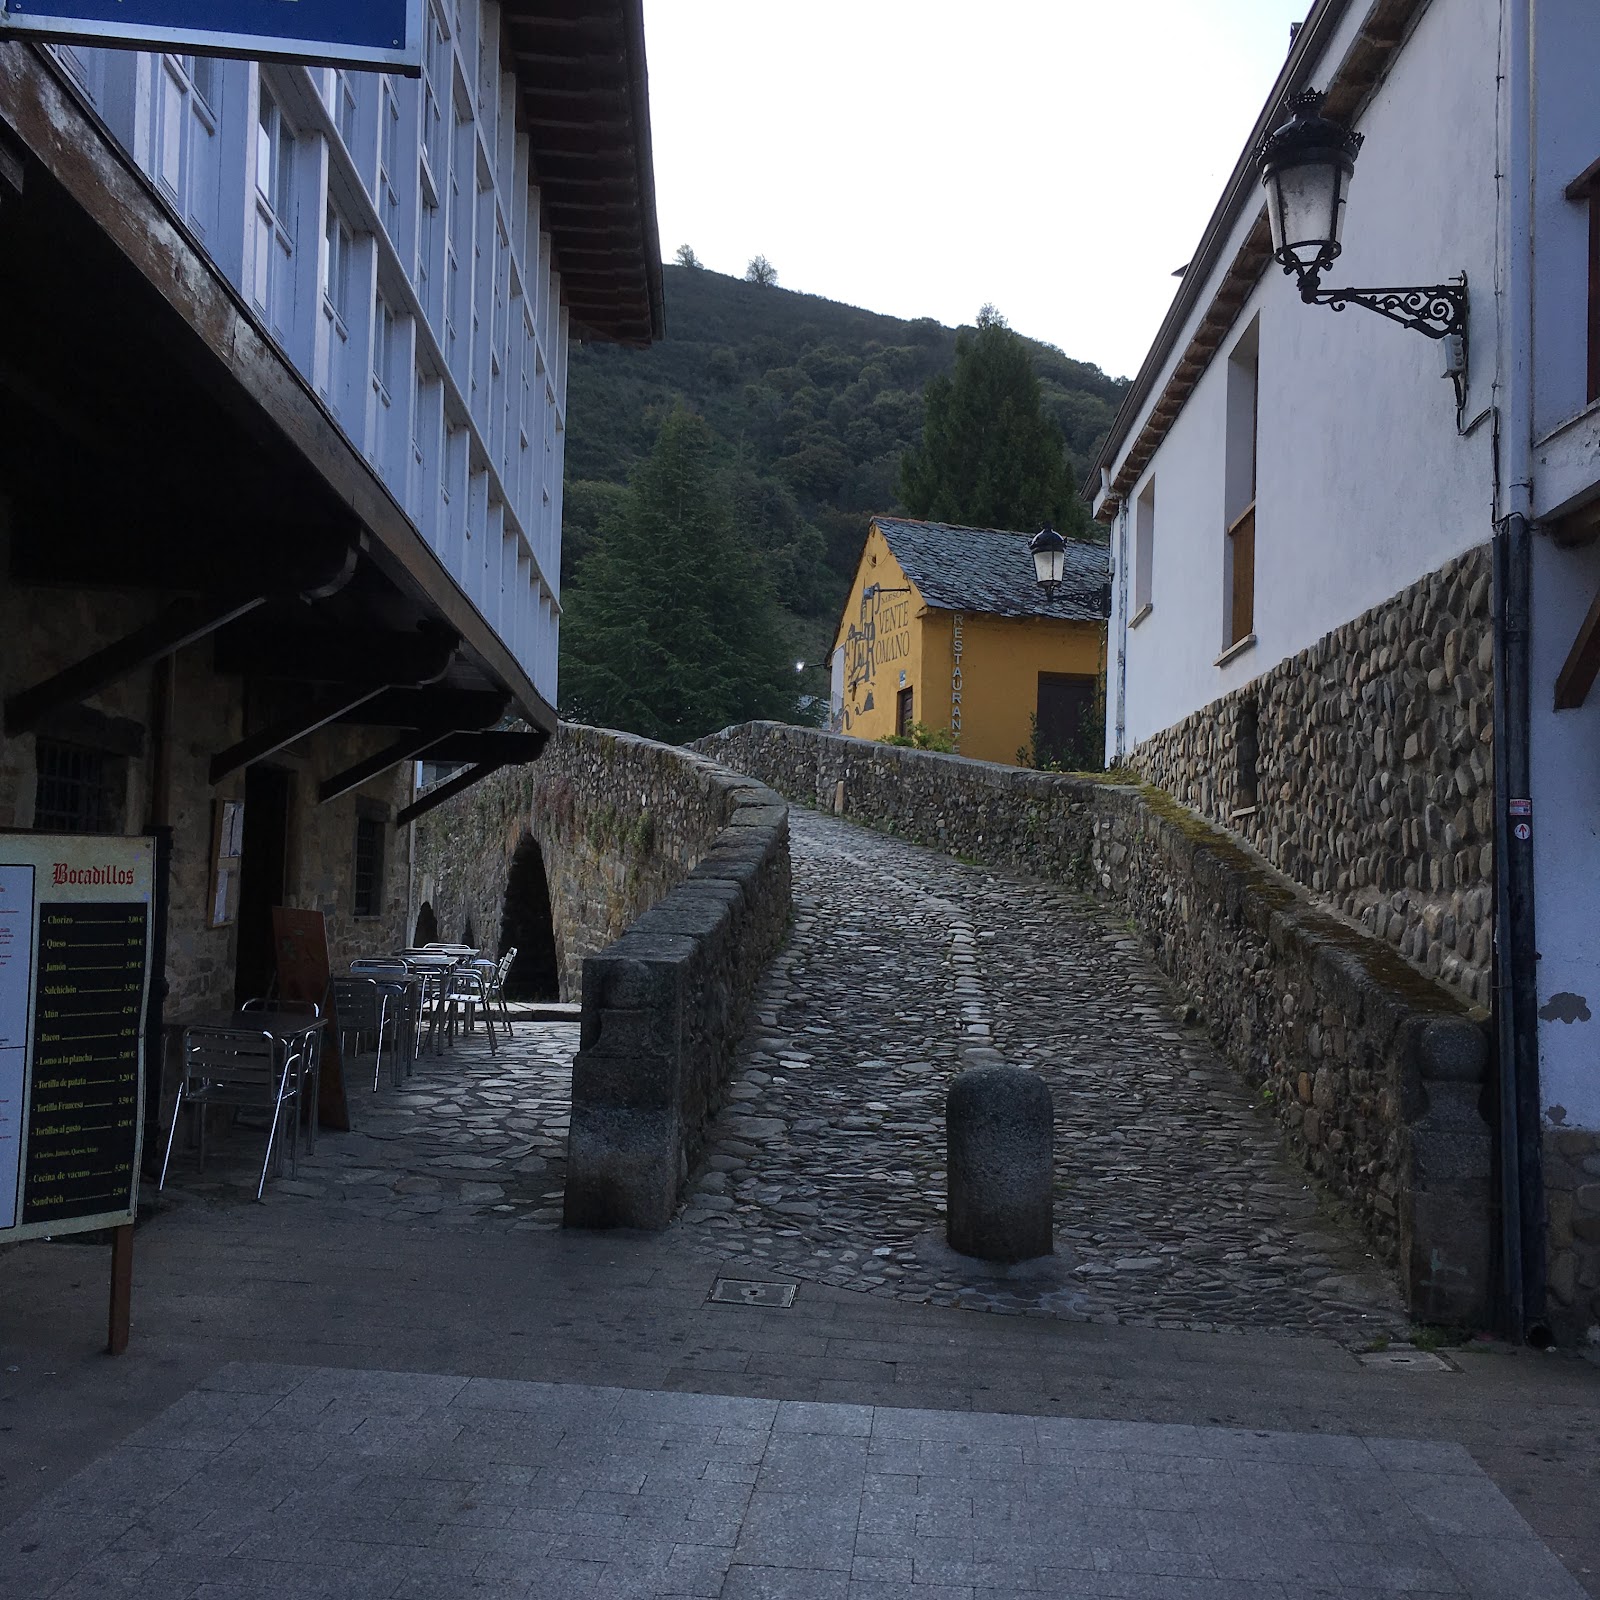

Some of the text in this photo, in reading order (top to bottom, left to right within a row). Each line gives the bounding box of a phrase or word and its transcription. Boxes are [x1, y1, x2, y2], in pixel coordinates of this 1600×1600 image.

[52, 863, 134, 888] Bocadillos
[48, 915, 74, 924] Chorizo
[46, 938, 66, 948] Queso
[46, 962, 66, 972] Jamón
[44, 985, 77, 995] Salchichón
[43, 1009, 58, 1018] Atún
[42, 1034, 60, 1042] Bacon
[40, 1056, 57, 1066] Lomo
[63, 1055, 69, 1064] la
[69, 1054, 93, 1065] plancha
[38, 1079, 59, 1089] Tortilla
[60, 1078, 67, 1087] de
[37, 1104, 58, 1112] Tortilla
[58, 1102, 84, 1111] Francesa
[36, 1126, 59, 1136] Tortillas
[65, 1124, 81, 1134] gusto
[33, 1173, 56, 1184] Cecina
[57, 1172, 65, 1180] de
[67, 1170, 90, 1179] vacuno
[32, 1195, 64, 1208] Sandwich
